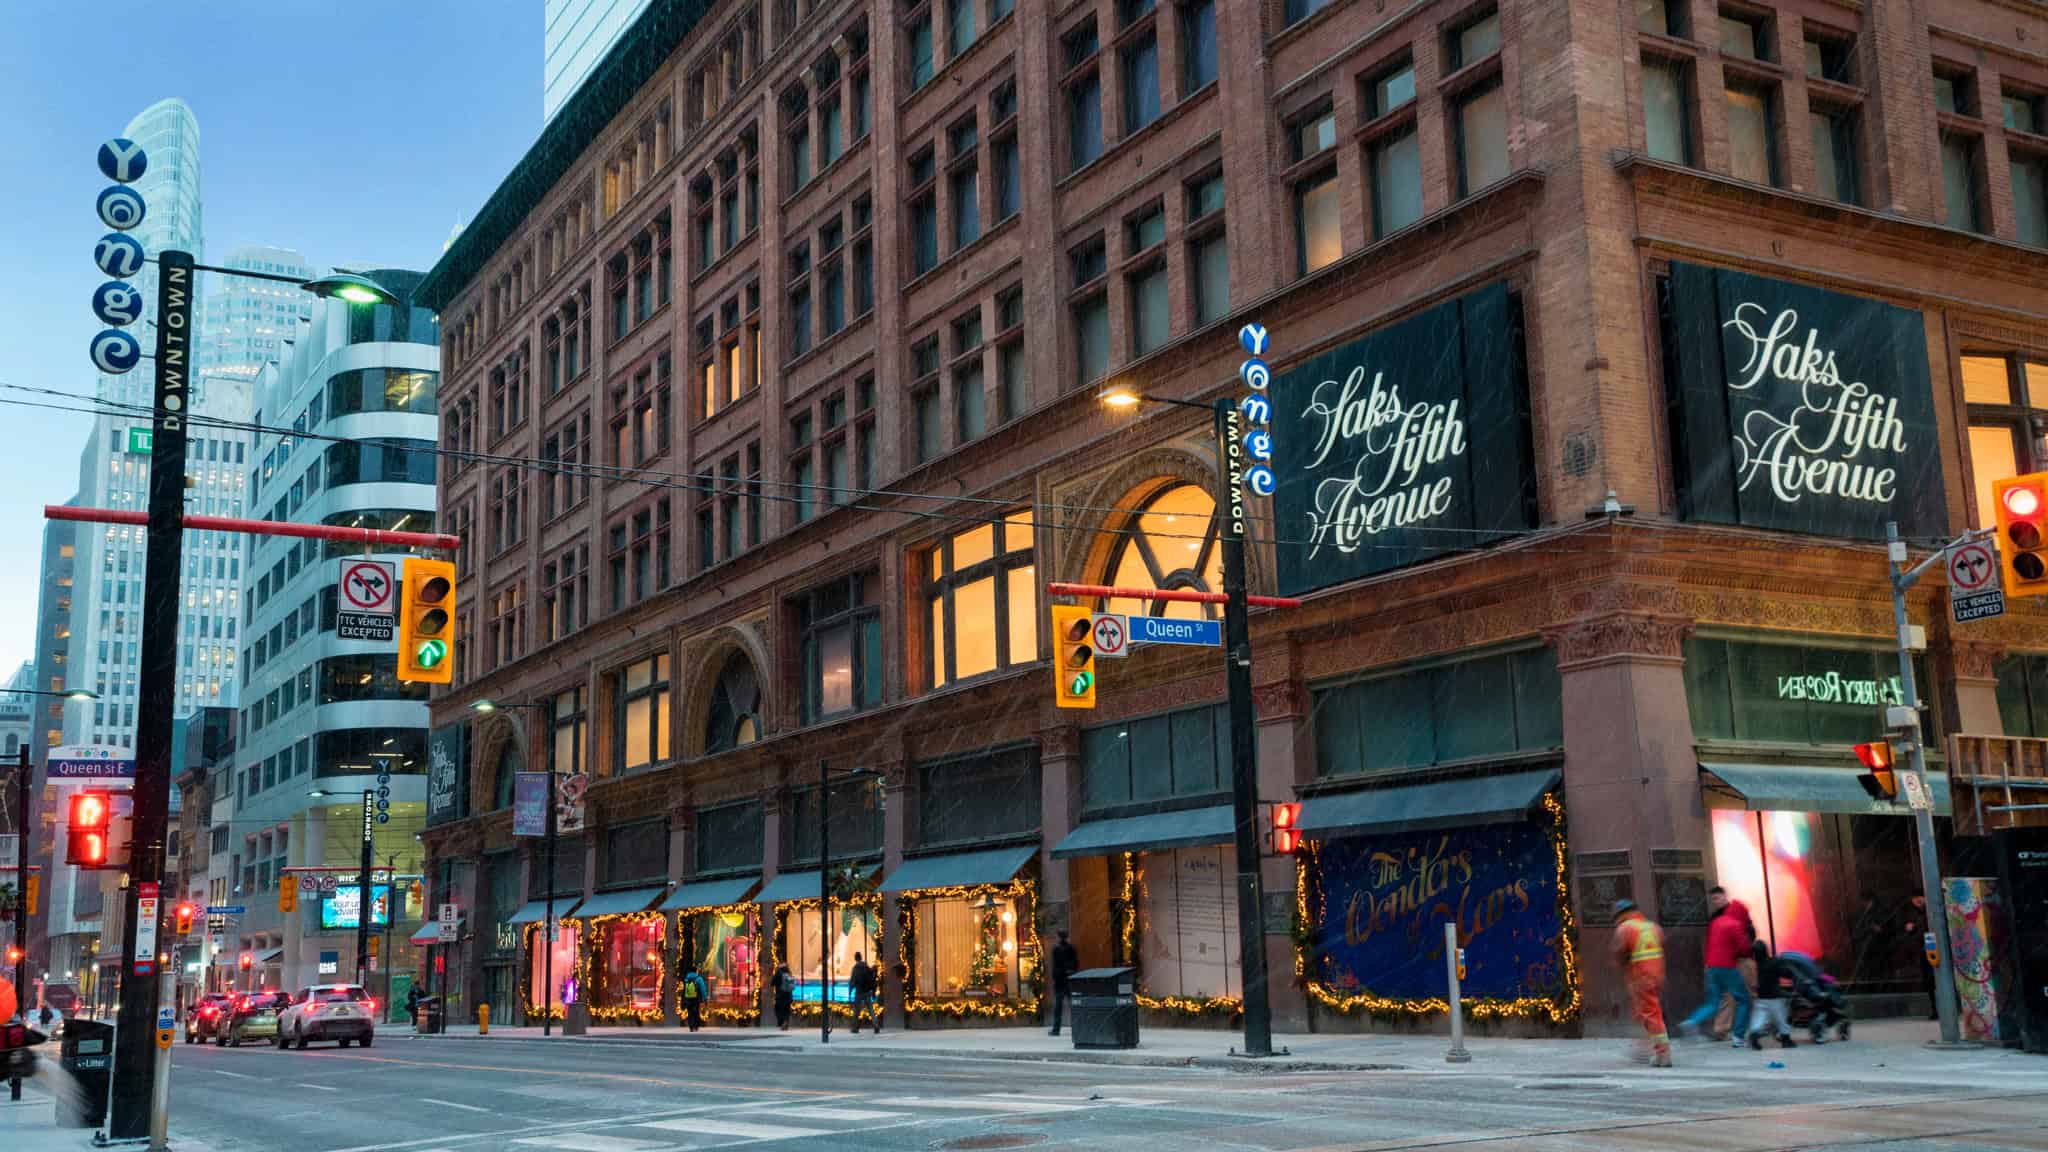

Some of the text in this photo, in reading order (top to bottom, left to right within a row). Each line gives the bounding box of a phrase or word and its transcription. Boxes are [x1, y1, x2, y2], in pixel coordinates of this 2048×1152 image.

[163, 267, 186, 432] DOWNTOWN
[1723, 302, 1839, 390] Saks
[1302, 366, 1401, 469] Saks
[1227, 410, 1244, 534] DOWNTOWN
[1733, 410, 1897, 503] Avenue
[1306, 476, 1452, 560] Avenue
[1953, 593, 2001, 609] TTC VEHICLES
[1957, 603, 2001, 619] EXCEPTED
[340, 615, 393, 627] TTC VEHICLES
[341, 626, 391, 638] EXCEPTED
[1146, 619, 1192, 638] Queen
[59, 761, 91, 774] Queen
[118, 764, 125, 774] E
[1370, 852, 1400, 889] The
